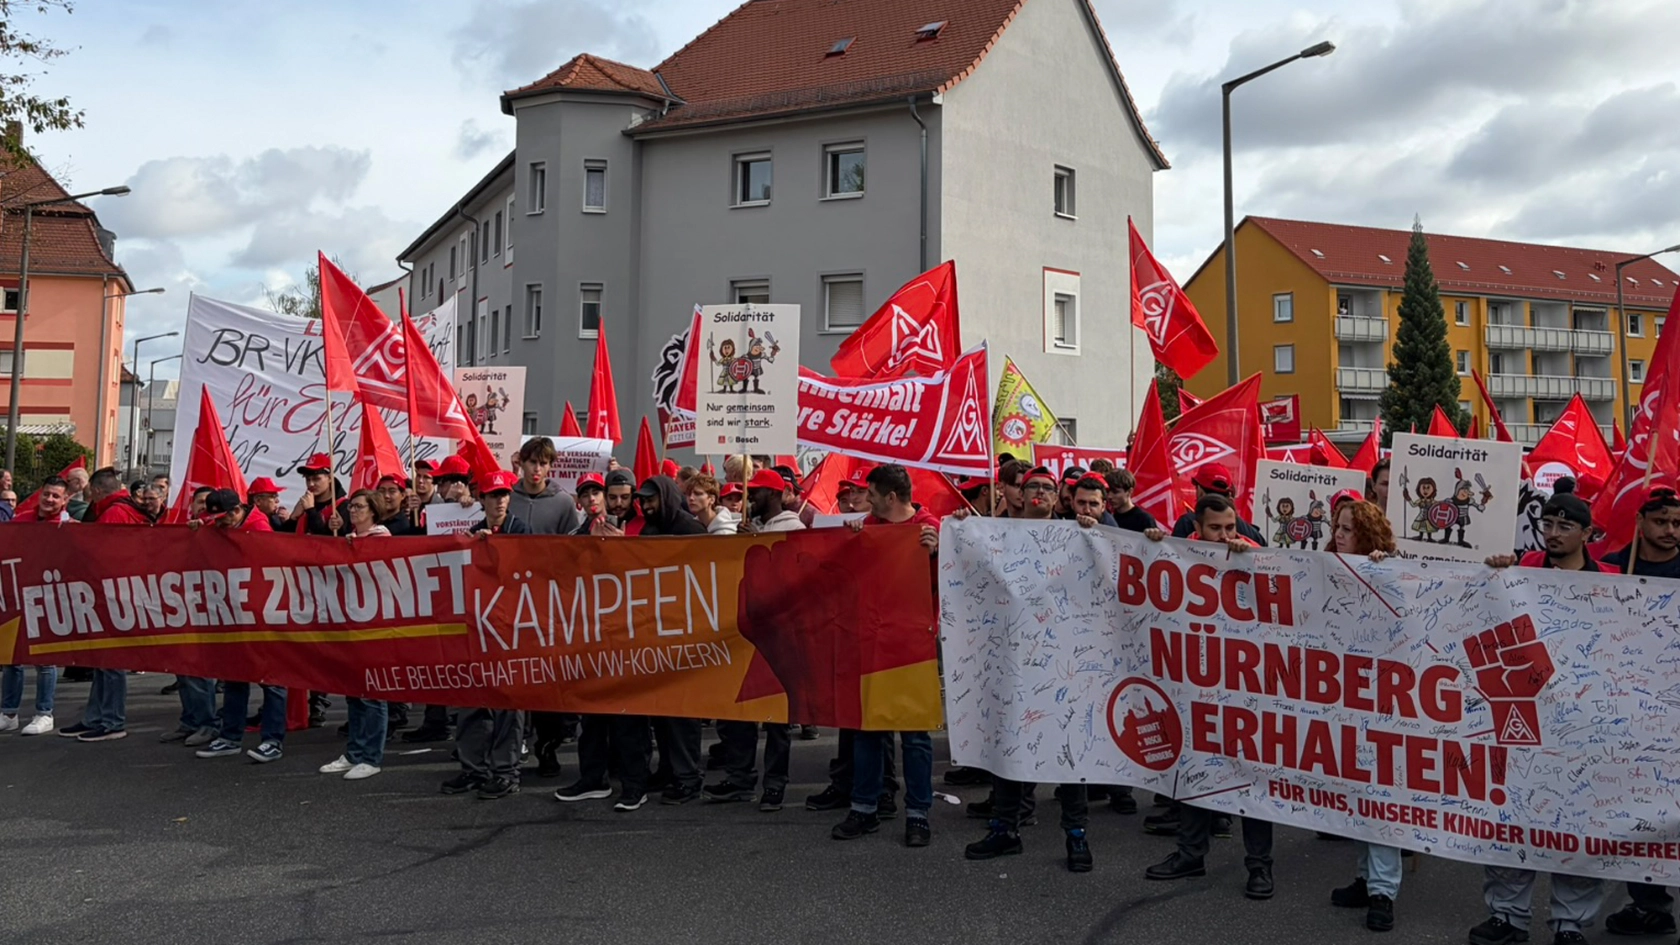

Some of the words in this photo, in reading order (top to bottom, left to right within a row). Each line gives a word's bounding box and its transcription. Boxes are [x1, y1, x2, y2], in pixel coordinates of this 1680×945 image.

[713, 312, 775, 323] Solidarität
[462, 372, 507, 382] Solidarität
[706, 403, 723, 412] Nur
[726, 403, 775, 414] gemeinsam
[706, 417, 724, 427] sind
[727, 418, 741, 427] wir
[744, 417, 773, 428] stark.
[825, 408, 918, 447] Stärke!
[735, 435, 759, 444] Bosch
[1408, 443, 1488, 462] Solidarität
[1270, 468, 1338, 486] Solidarität
[1118, 553, 1293, 626] BOSCH
[22, 569, 104, 639] FÜR
[102, 567, 256, 632] UNSERE
[262, 549, 472, 625] ZUKUNFT
[474, 561, 719, 653] KÄMPFEN
[365, 667, 405, 692] ALLE
[406, 656, 556, 691] BELEGSCHAFTEN
[560, 653, 587, 680] IM
[587, 640, 732, 678] VW-KONZERN
[1150, 621, 1461, 722] NÜRNBERG
[1143, 735, 1162, 747] BOSCH
[1144, 749, 1174, 764] NÜRNBERG
[1191, 701, 1507, 806] ERHALTEN!
[1268, 778, 1306, 803] FÜR
[1309, 789, 1353, 816] UNS,
[1357, 798, 1438, 829] UNSERE
[1443, 812, 1525, 845] KINDER
[1530, 828, 1580, 853] UND
[1585, 836, 1680, 861] UNSERE
